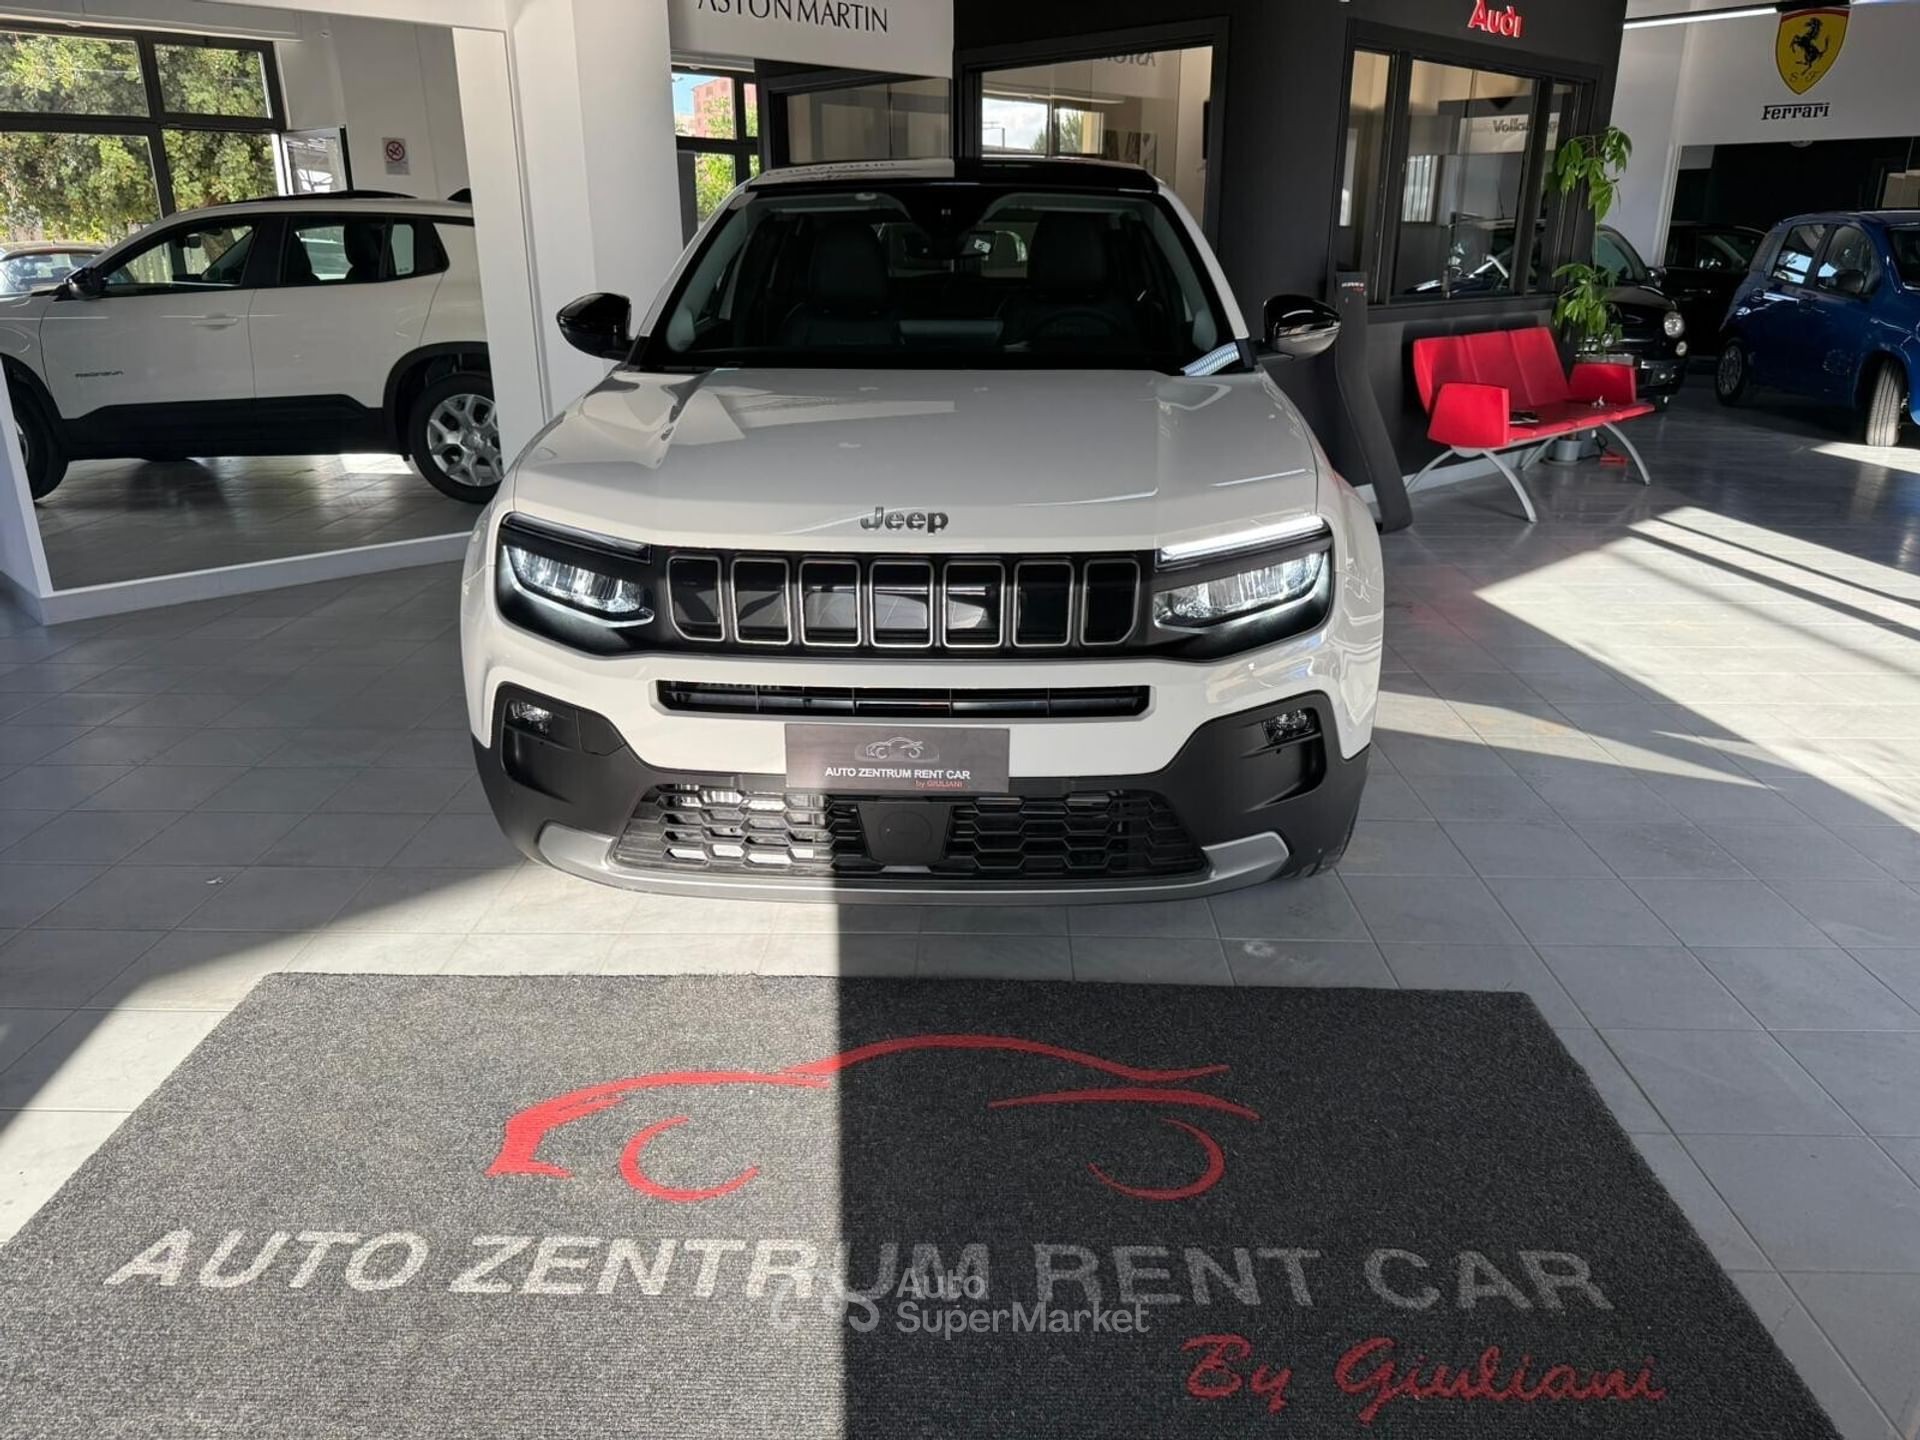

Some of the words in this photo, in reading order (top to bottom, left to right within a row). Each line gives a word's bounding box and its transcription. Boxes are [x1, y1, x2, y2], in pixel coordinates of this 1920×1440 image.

[797, 0, 888, 32] MARTIN
[1467, 0, 1522, 38] Audi
[1761, 102, 1830, 120] Ferrari
[860, 506, 949, 534] Jeep
[825, 767, 857, 777] AUTO
[858, 768, 912, 778] ZENTRUM
[914, 769, 944, 779] RENT
[946, 770, 971, 780] CAR
[102, 1228, 430, 1291] AUTO
[449, 1235, 990, 1301] ZENTRUM
[1034, 1243, 1321, 1306] RENT
[1364, 1247, 1614, 1309] CAR
[1181, 1333, 1294, 1415] By
[1333, 1337, 1667, 1427] Giuliani
